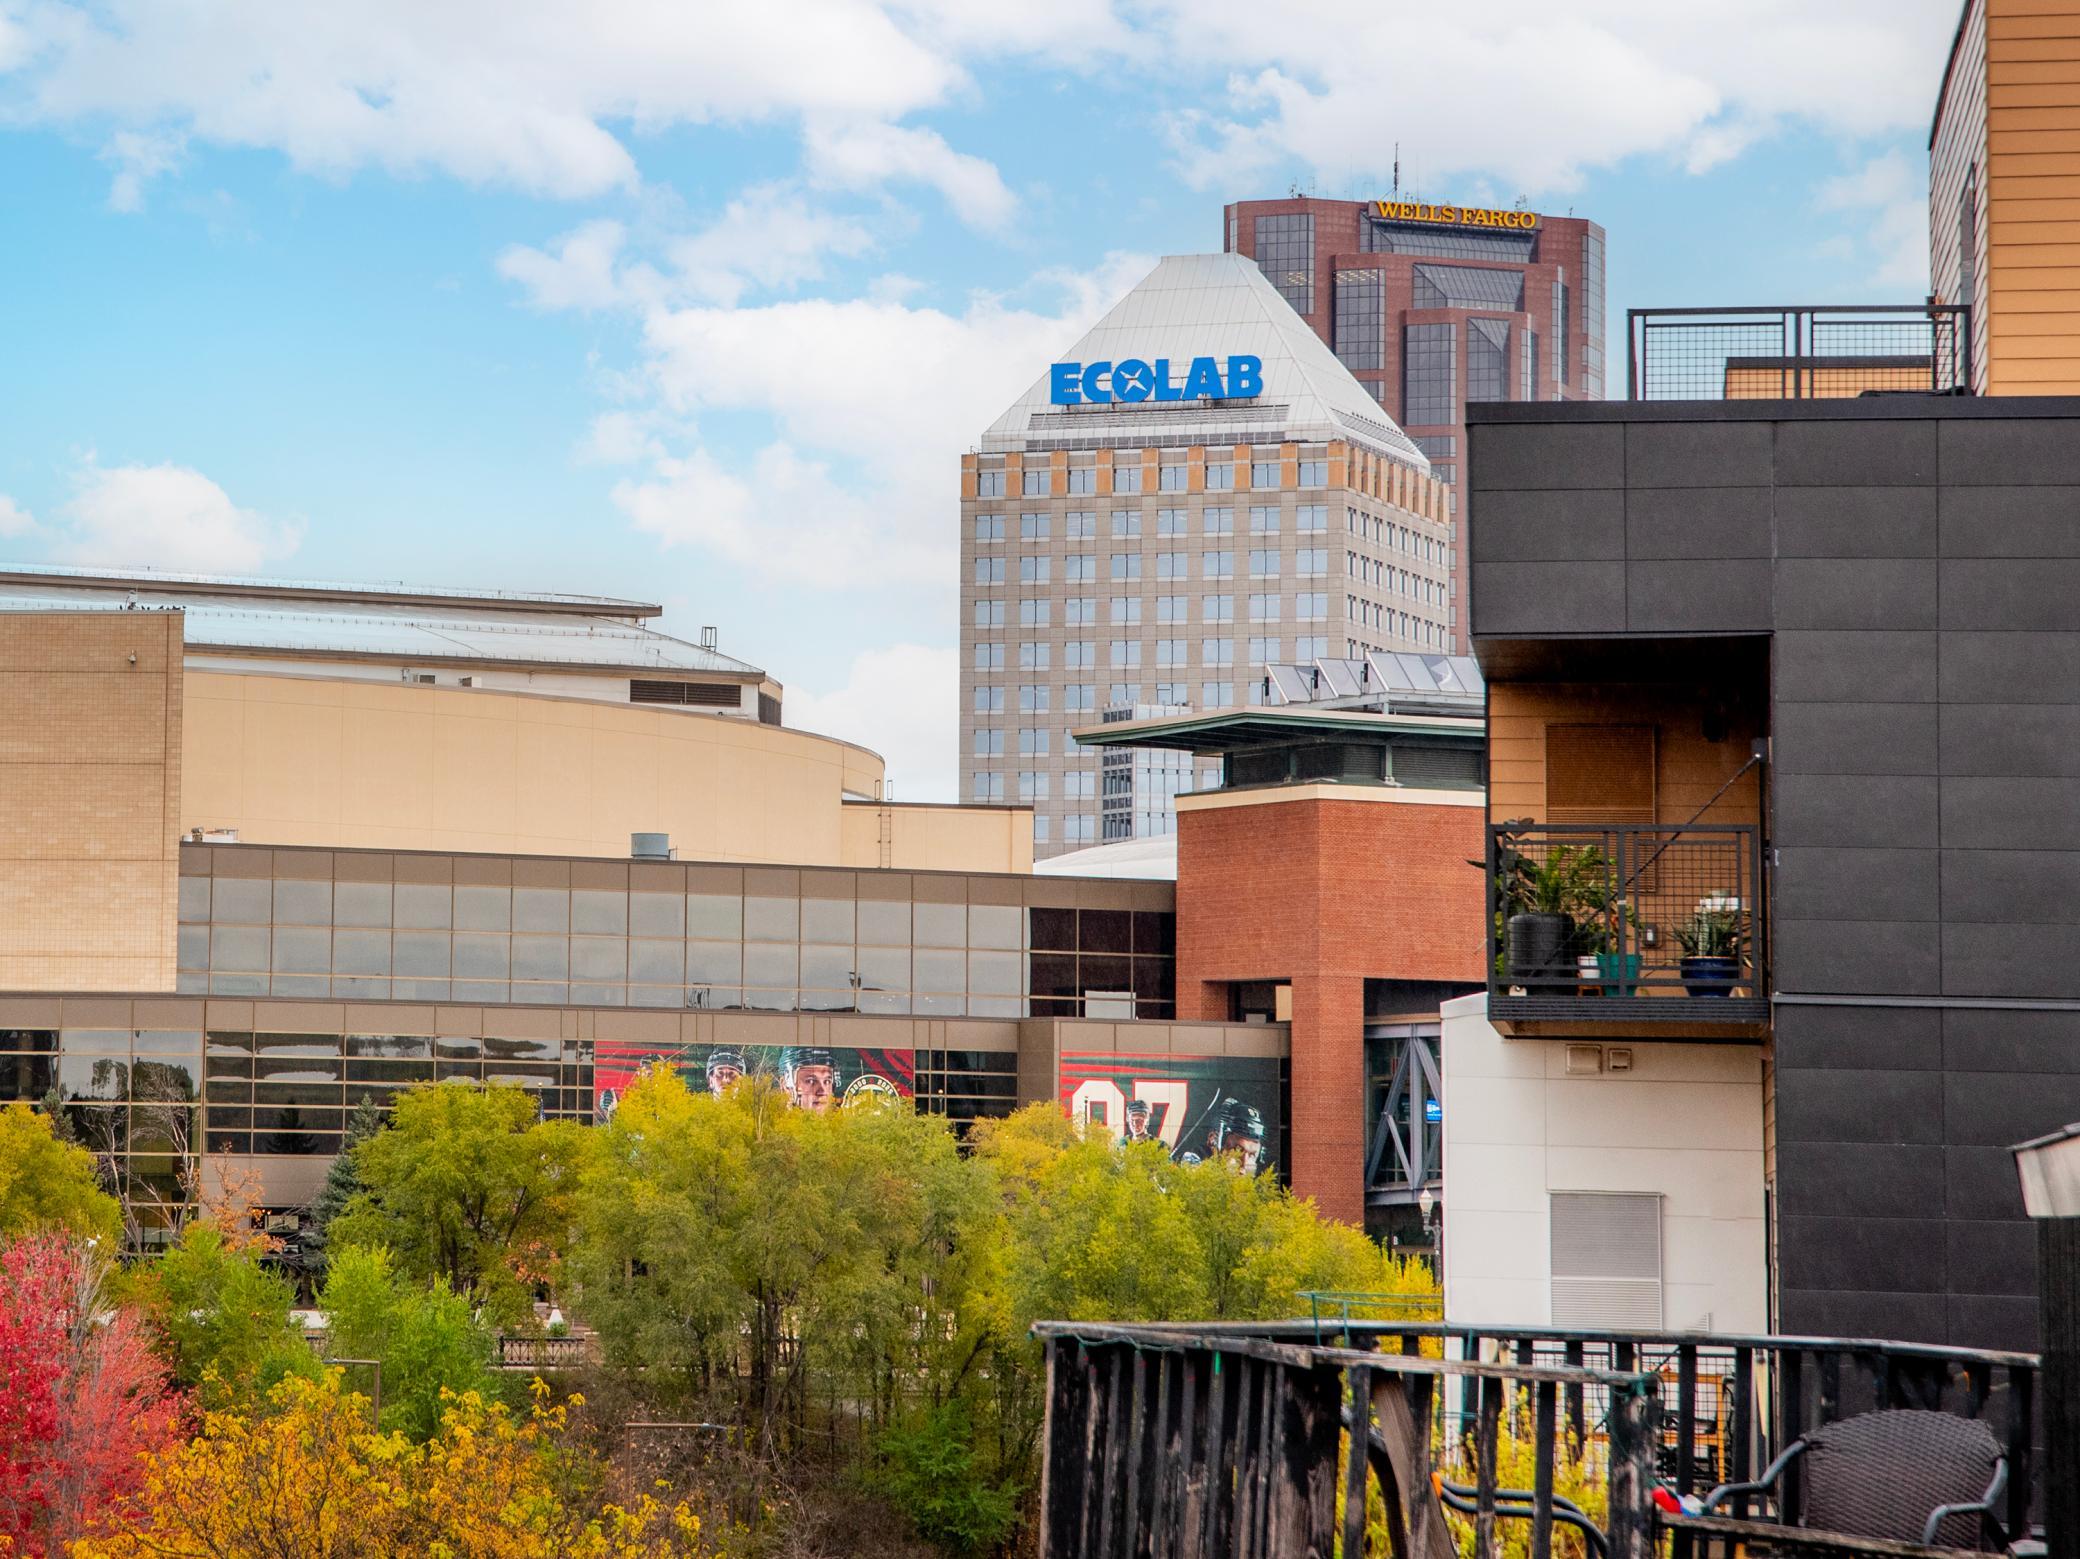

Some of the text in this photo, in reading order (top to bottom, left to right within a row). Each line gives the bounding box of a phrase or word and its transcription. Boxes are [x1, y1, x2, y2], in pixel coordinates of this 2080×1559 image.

[1377, 200, 1537, 229] WELLS FARGO
[1050, 354, 1264, 405] ECOLAB
